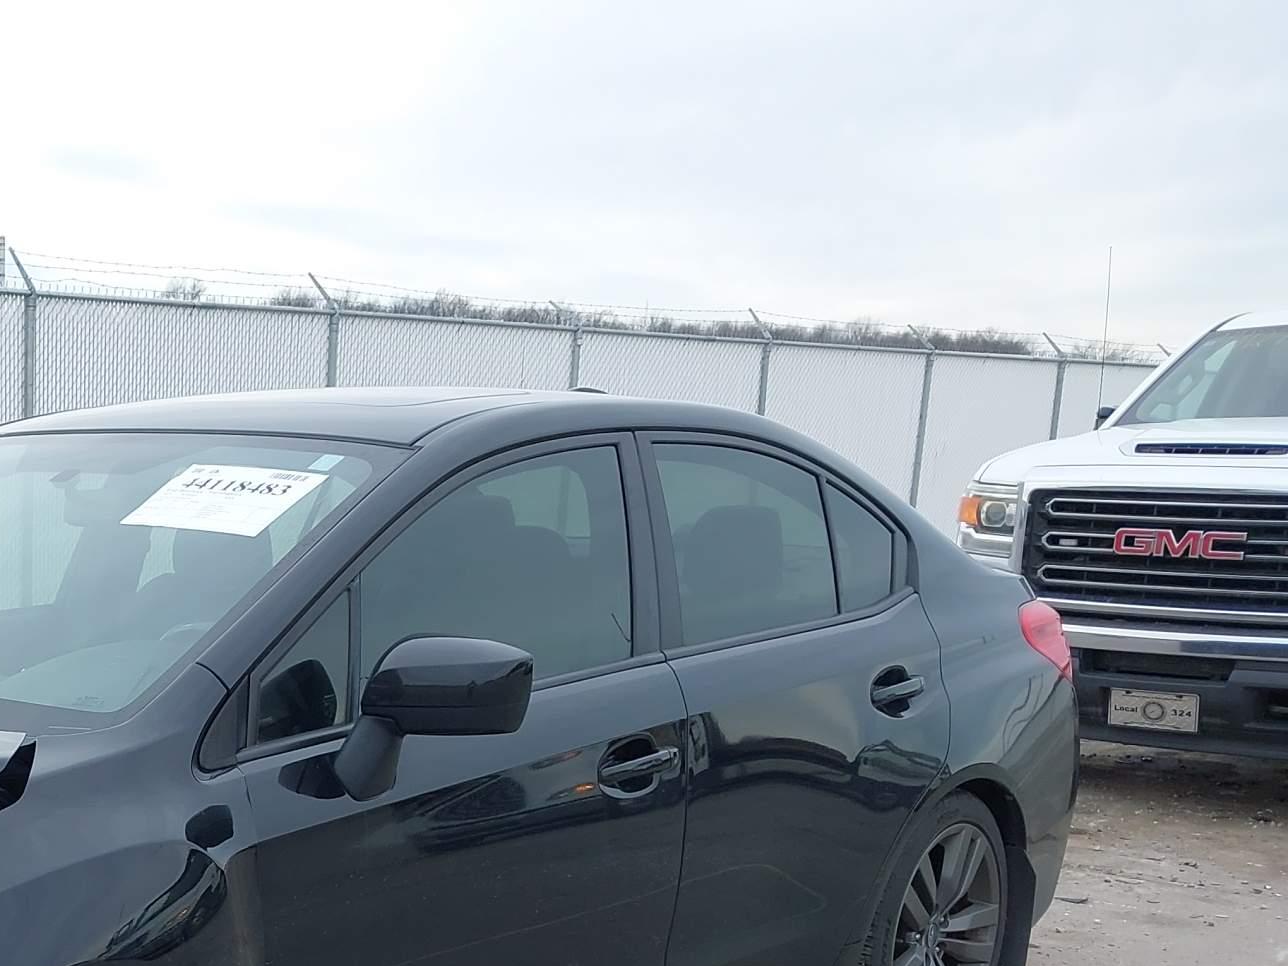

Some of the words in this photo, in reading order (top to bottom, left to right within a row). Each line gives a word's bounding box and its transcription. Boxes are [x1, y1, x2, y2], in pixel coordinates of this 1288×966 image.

[183, 478, 292, 497] 44118483
[1113, 528, 1248, 561] GMC
[1114, 704, 1138, 714] Local
[1170, 709, 1192, 718] 324
